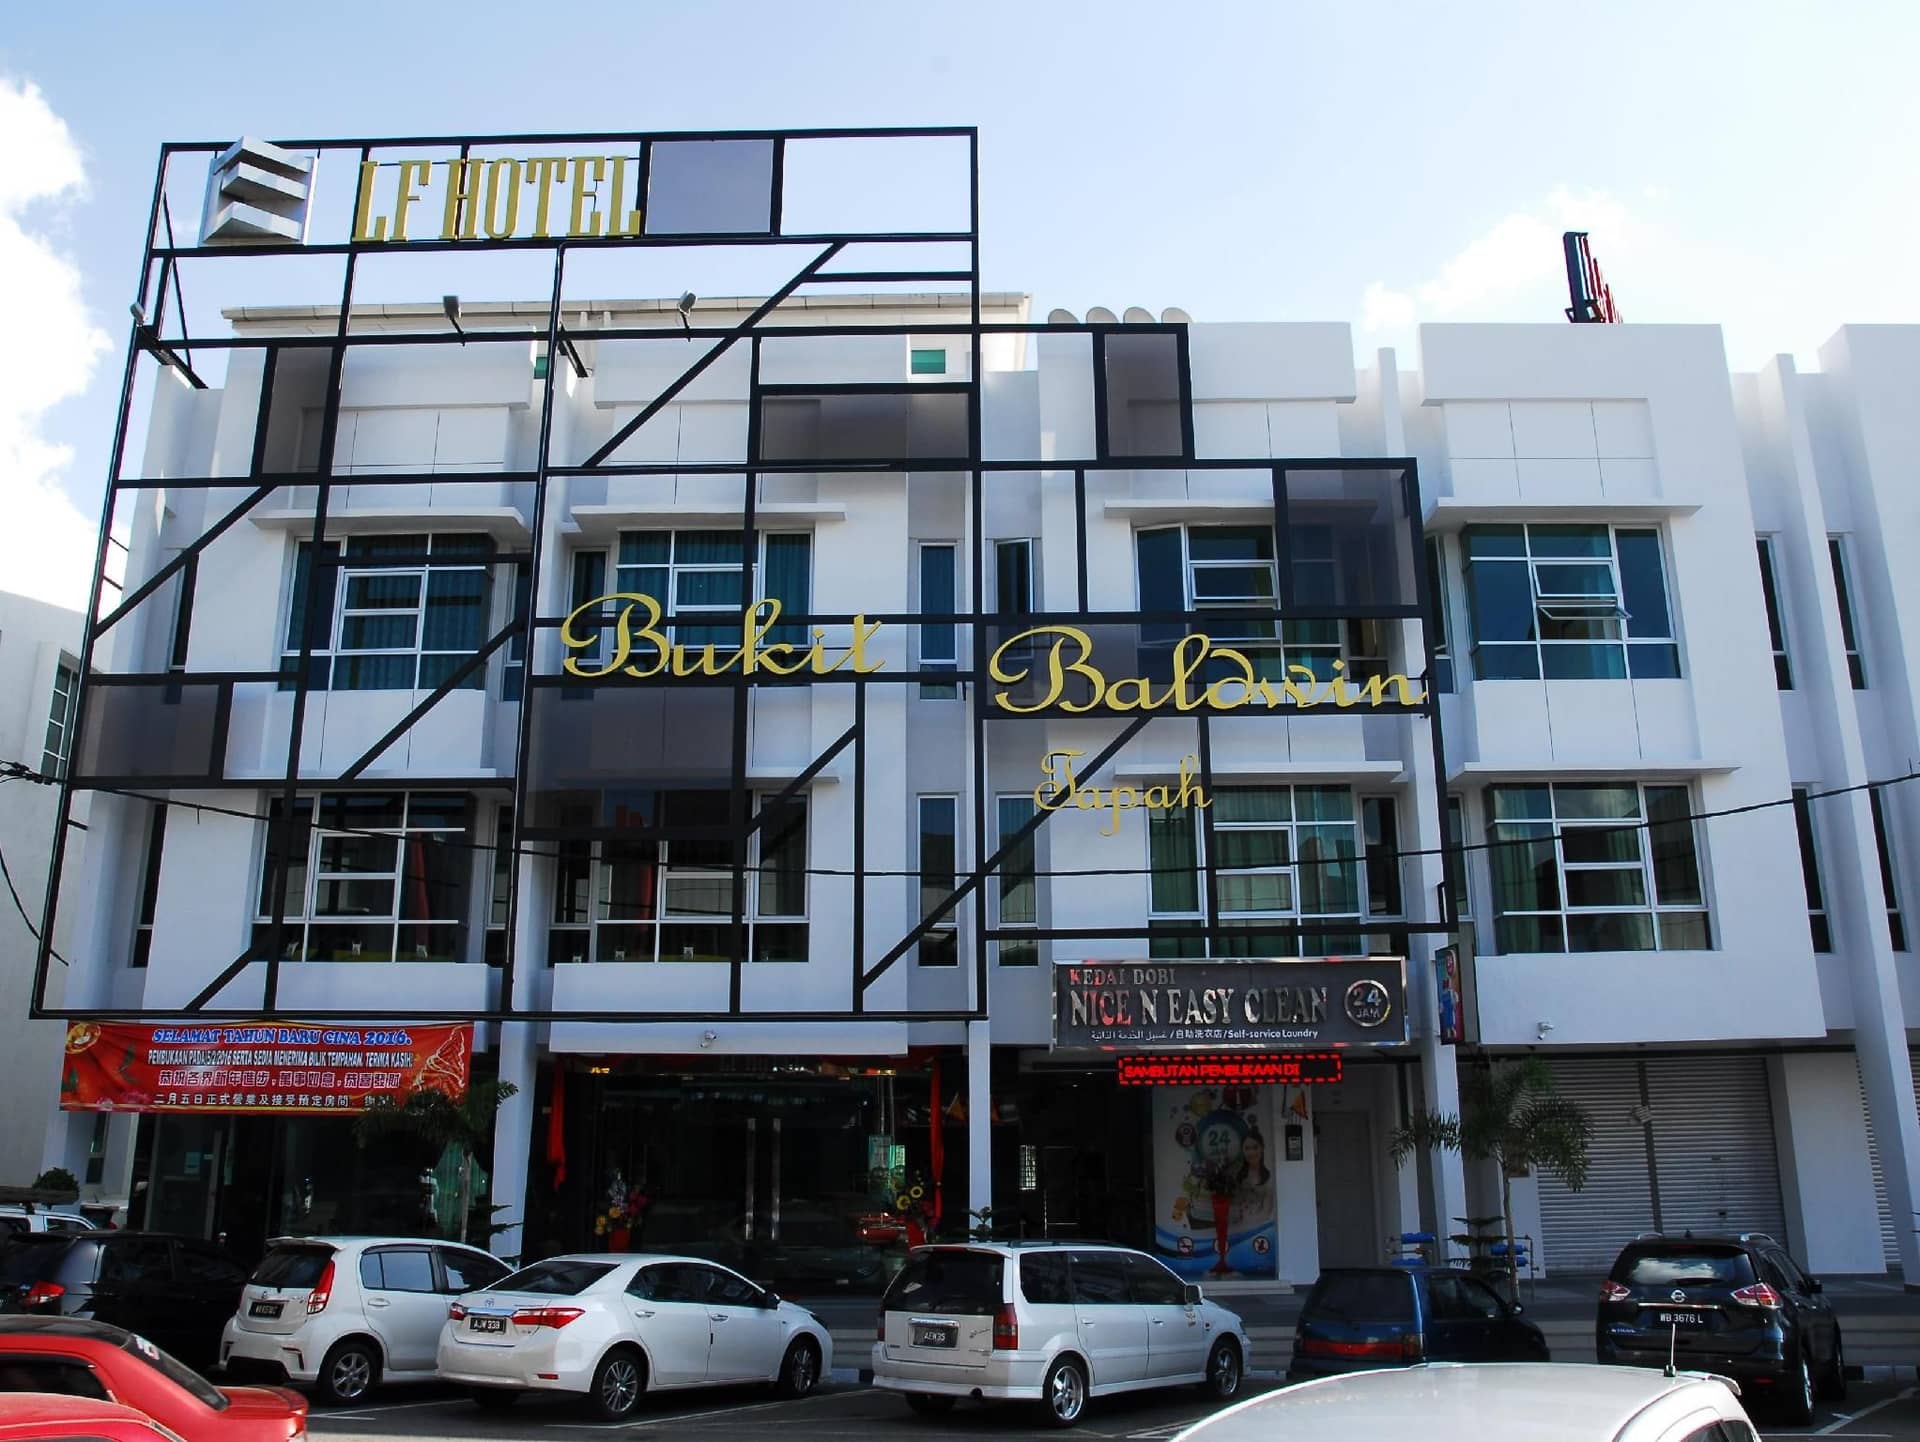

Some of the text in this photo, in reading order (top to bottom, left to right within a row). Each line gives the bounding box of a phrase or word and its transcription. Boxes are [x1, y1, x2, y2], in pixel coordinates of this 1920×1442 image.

[440, 156, 641, 240] HOTEL
[560, 592, 1428, 713] Bukit Baldwin
[1033, 748, 1213, 836] Tapah
[1069, 968, 1176, 986] KEDAI DOBI
[1070, 986, 1328, 1026] NICE N EASY CLEAN
[1353, 987, 1382, 1007] 24
[1356, 1007, 1381, 1019] JAM
[152, 1028, 222, 1044] SELAMAT
[223, 1028, 277, 1044] TAHUN
[278, 1028, 322, 1045] BARU
[323, 1030, 362, 1045] CINA
[1282, 1029, 1319, 1039] Laundry
[148, 1049, 188, 1065] PEMBUKAAN
[232, 1050, 253, 1065] SERTA
[254, 1050, 273, 1065] SEDIA
[274, 1050, 307, 1066] MENERIMA
[308, 1051, 326, 1066] BILIK
[365, 1052, 389, 1067] TERIMA
[1124, 1064, 1199, 1077] SAMBUTAN
[1200, 1063, 1282, 1077] PEMBUKAAN
